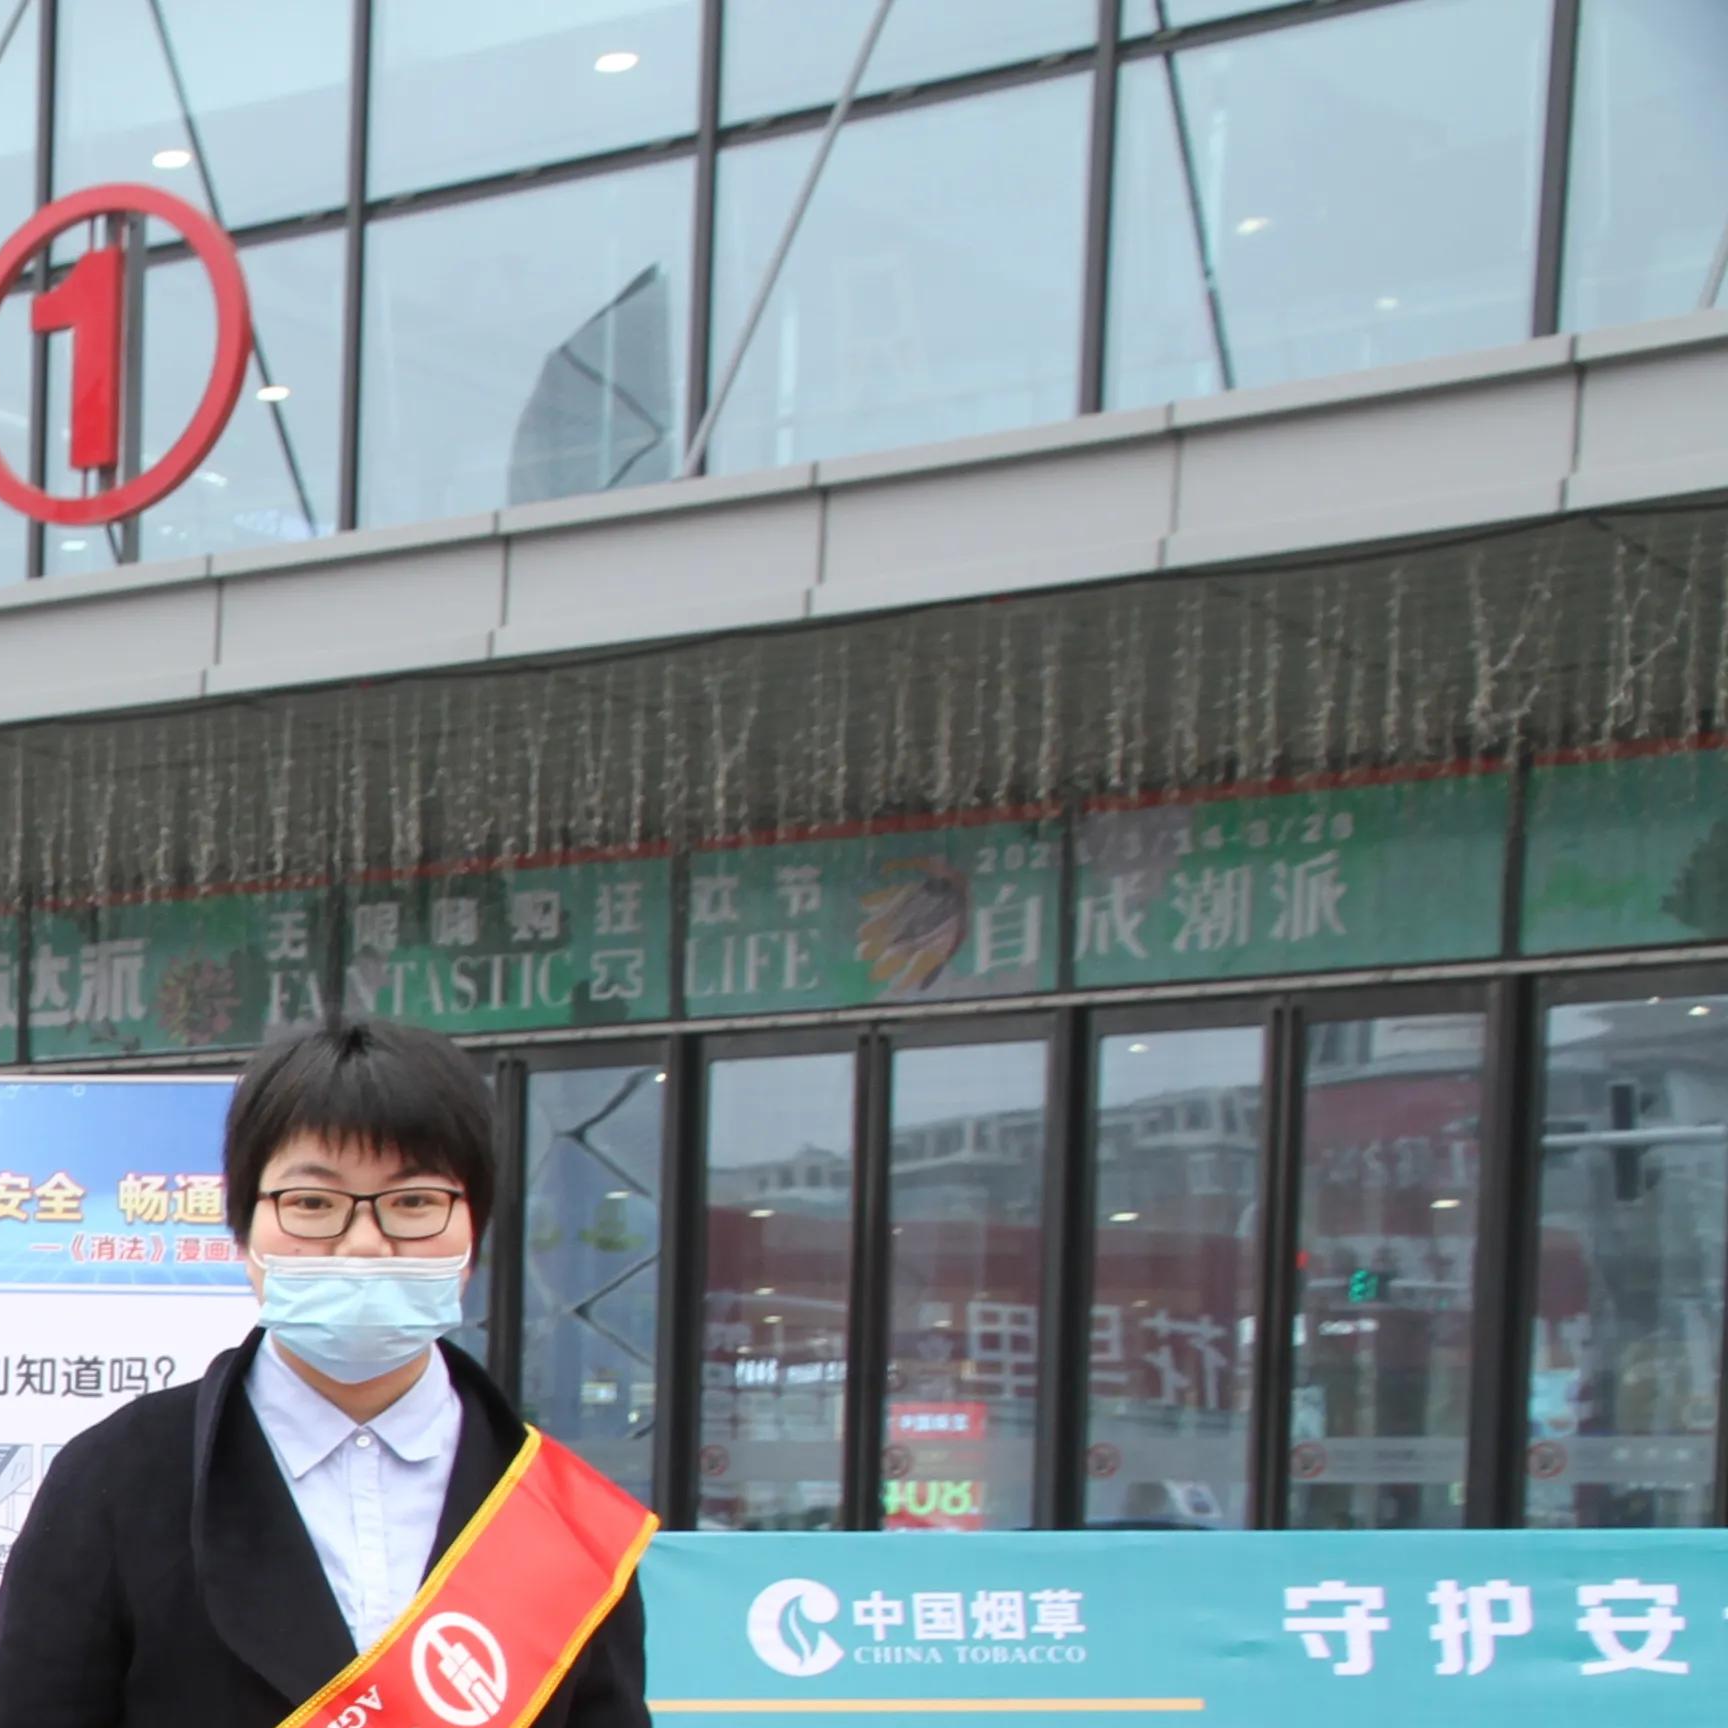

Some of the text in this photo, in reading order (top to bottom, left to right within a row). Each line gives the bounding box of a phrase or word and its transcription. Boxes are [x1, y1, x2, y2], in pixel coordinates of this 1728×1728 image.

[973, 849, 1348, 974] 自成潮派
[686, 929, 822, 996] LIFE
[851, 1588, 1087, 1642] 中国烟草
[1282, 1578, 1728, 1677] 守护安
[853, 1644, 1087, 1665] CHINA TOBACCO
